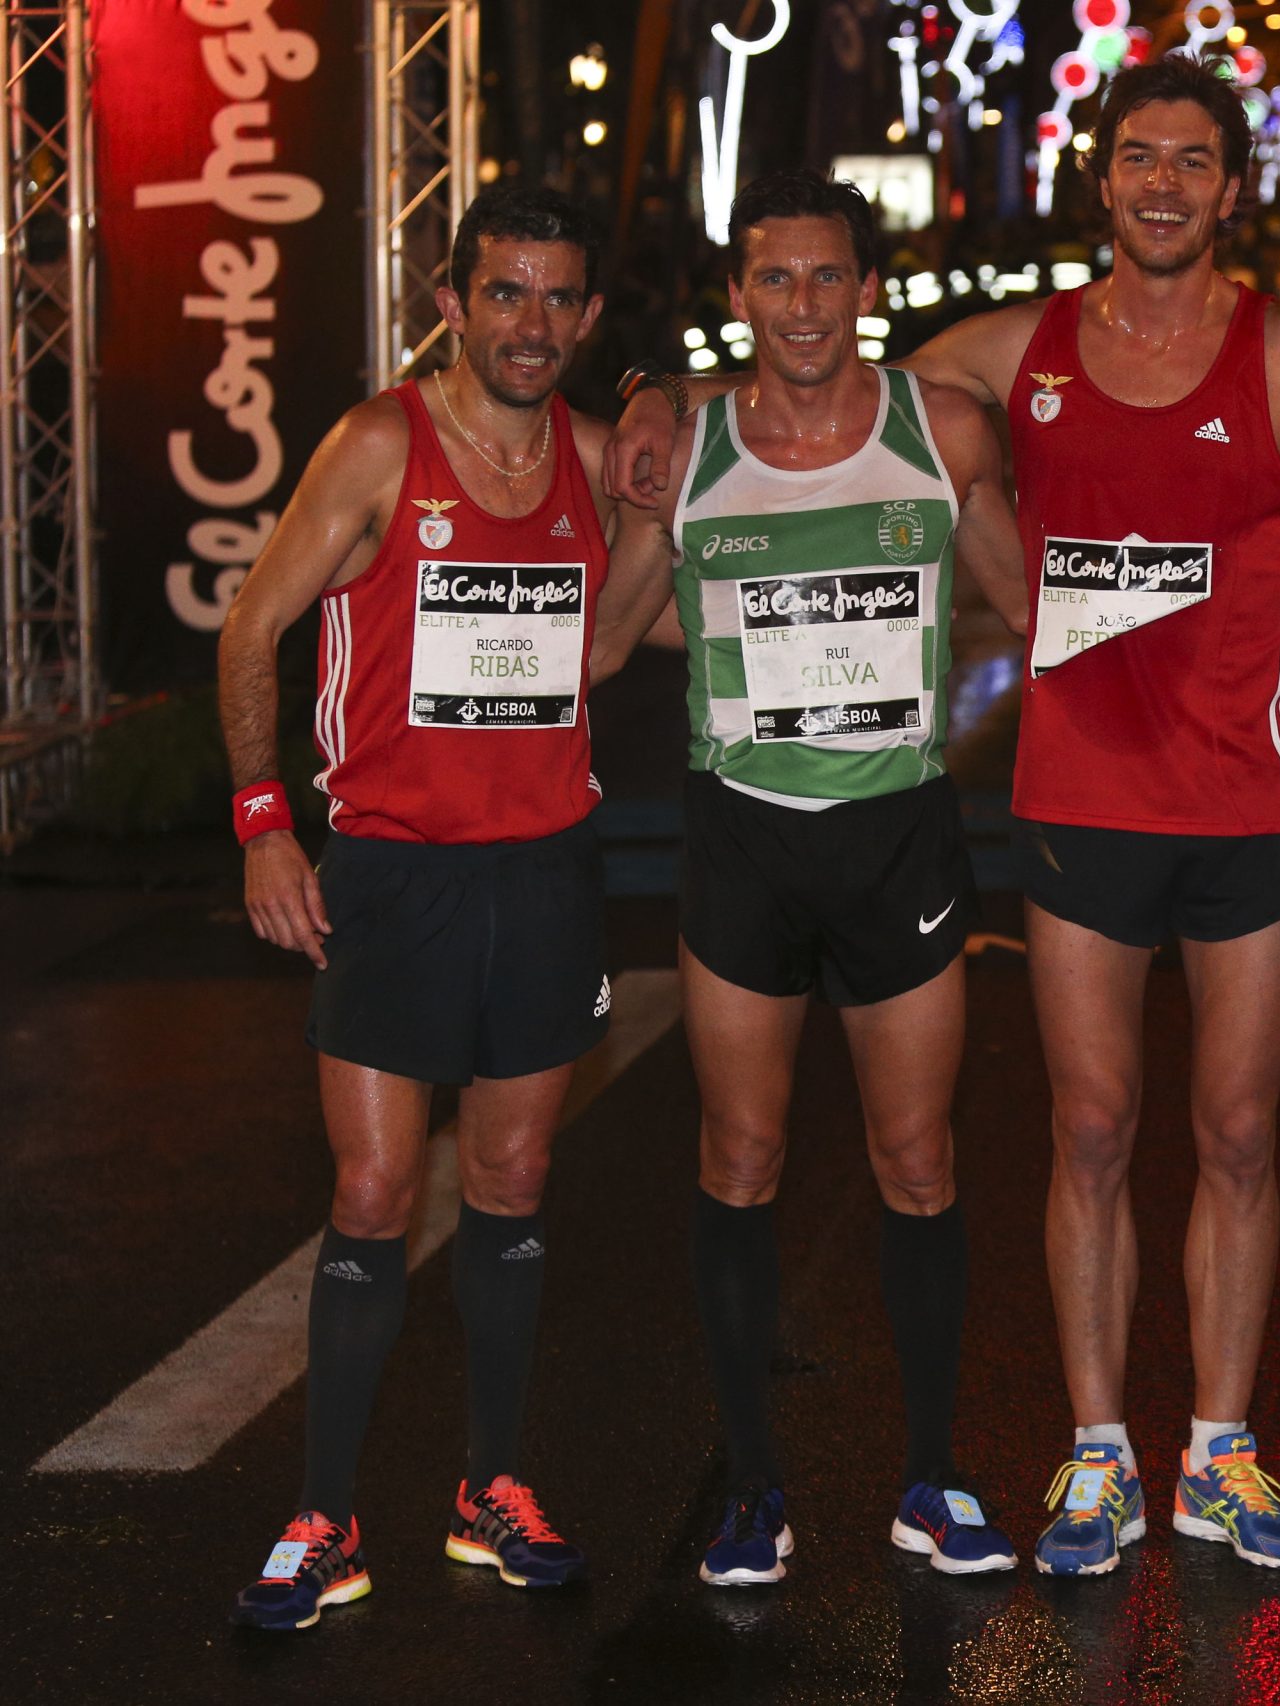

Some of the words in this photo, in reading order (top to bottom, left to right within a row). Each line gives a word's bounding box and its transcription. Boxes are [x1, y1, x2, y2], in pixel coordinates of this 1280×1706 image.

[167, 236, 284, 508] Corte
[1194, 430, 1230, 443] adidas
[882, 501, 916, 513] SCP
[550, 528, 575, 538] adidas
[721, 535, 769, 554] asics
[1046, 549, 1065, 577] El
[1067, 552, 1116, 580] Corte
[1118, 548, 1203, 591] Inglés
[424, 573, 449, 601] El
[450, 576, 506, 602] Corte
[508, 570, 579, 614] Inglés
[744, 590, 770, 617] El
[771, 589, 830, 615] Corte
[834, 578, 915, 621] Inglés
[1043, 589, 1076, 603] ELITE
[1079, 592, 1088, 604] A
[420, 615, 465, 629] ELITE
[469, 616, 480, 628] A
[551, 615, 581, 628] 0005
[887, 618, 919, 632] 0002
[1097, 613, 1137, 628] JOÃO
[746, 629, 790, 645] ELITE
[476, 639, 533, 651] RICARDO
[826, 647, 850, 660] RUI
[470, 655, 539, 678] RIBAS
[802, 662, 879, 688] SILVA
[486, 702, 537, 717] LISBOA
[825, 709, 881, 726] LISBOA
[501, 1245, 544, 1261] adidas
[323, 1263, 373, 1283] adidas
